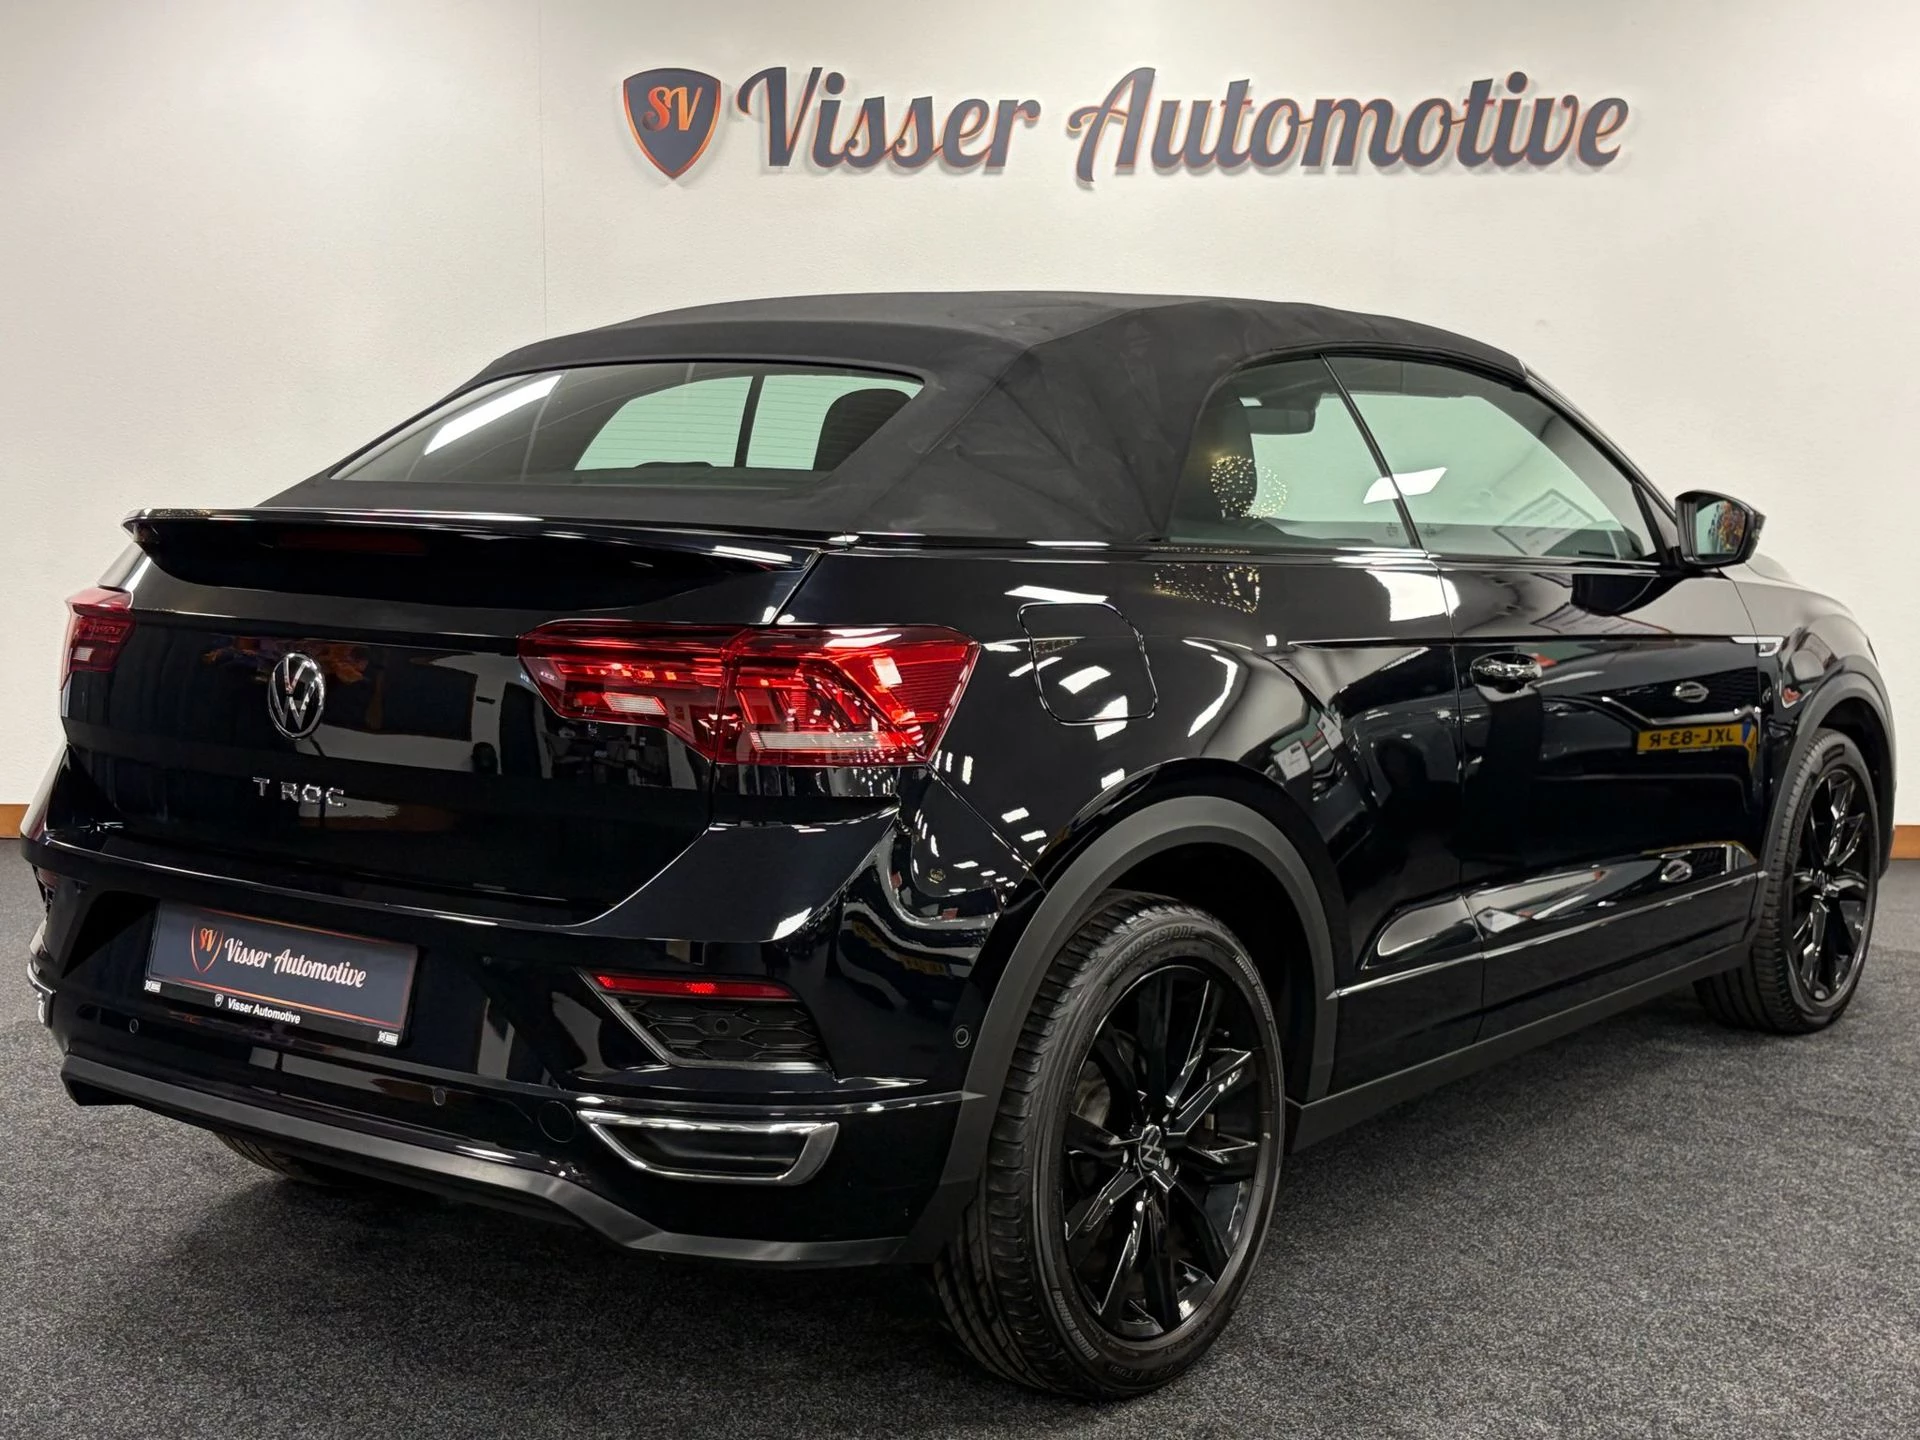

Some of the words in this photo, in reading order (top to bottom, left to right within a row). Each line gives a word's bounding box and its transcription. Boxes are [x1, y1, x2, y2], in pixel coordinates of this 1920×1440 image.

[642, 87, 703, 131] SV
[737, 66, 1041, 169] Visser
[1066, 66, 1630, 182] Automotive
[280, 781, 346, 807] ROC
[225, 938, 272, 968] Visser
[274, 949, 366, 988] Automotive
[228, 998, 254, 1014] Visser
[253, 1004, 301, 1024] Automotive
